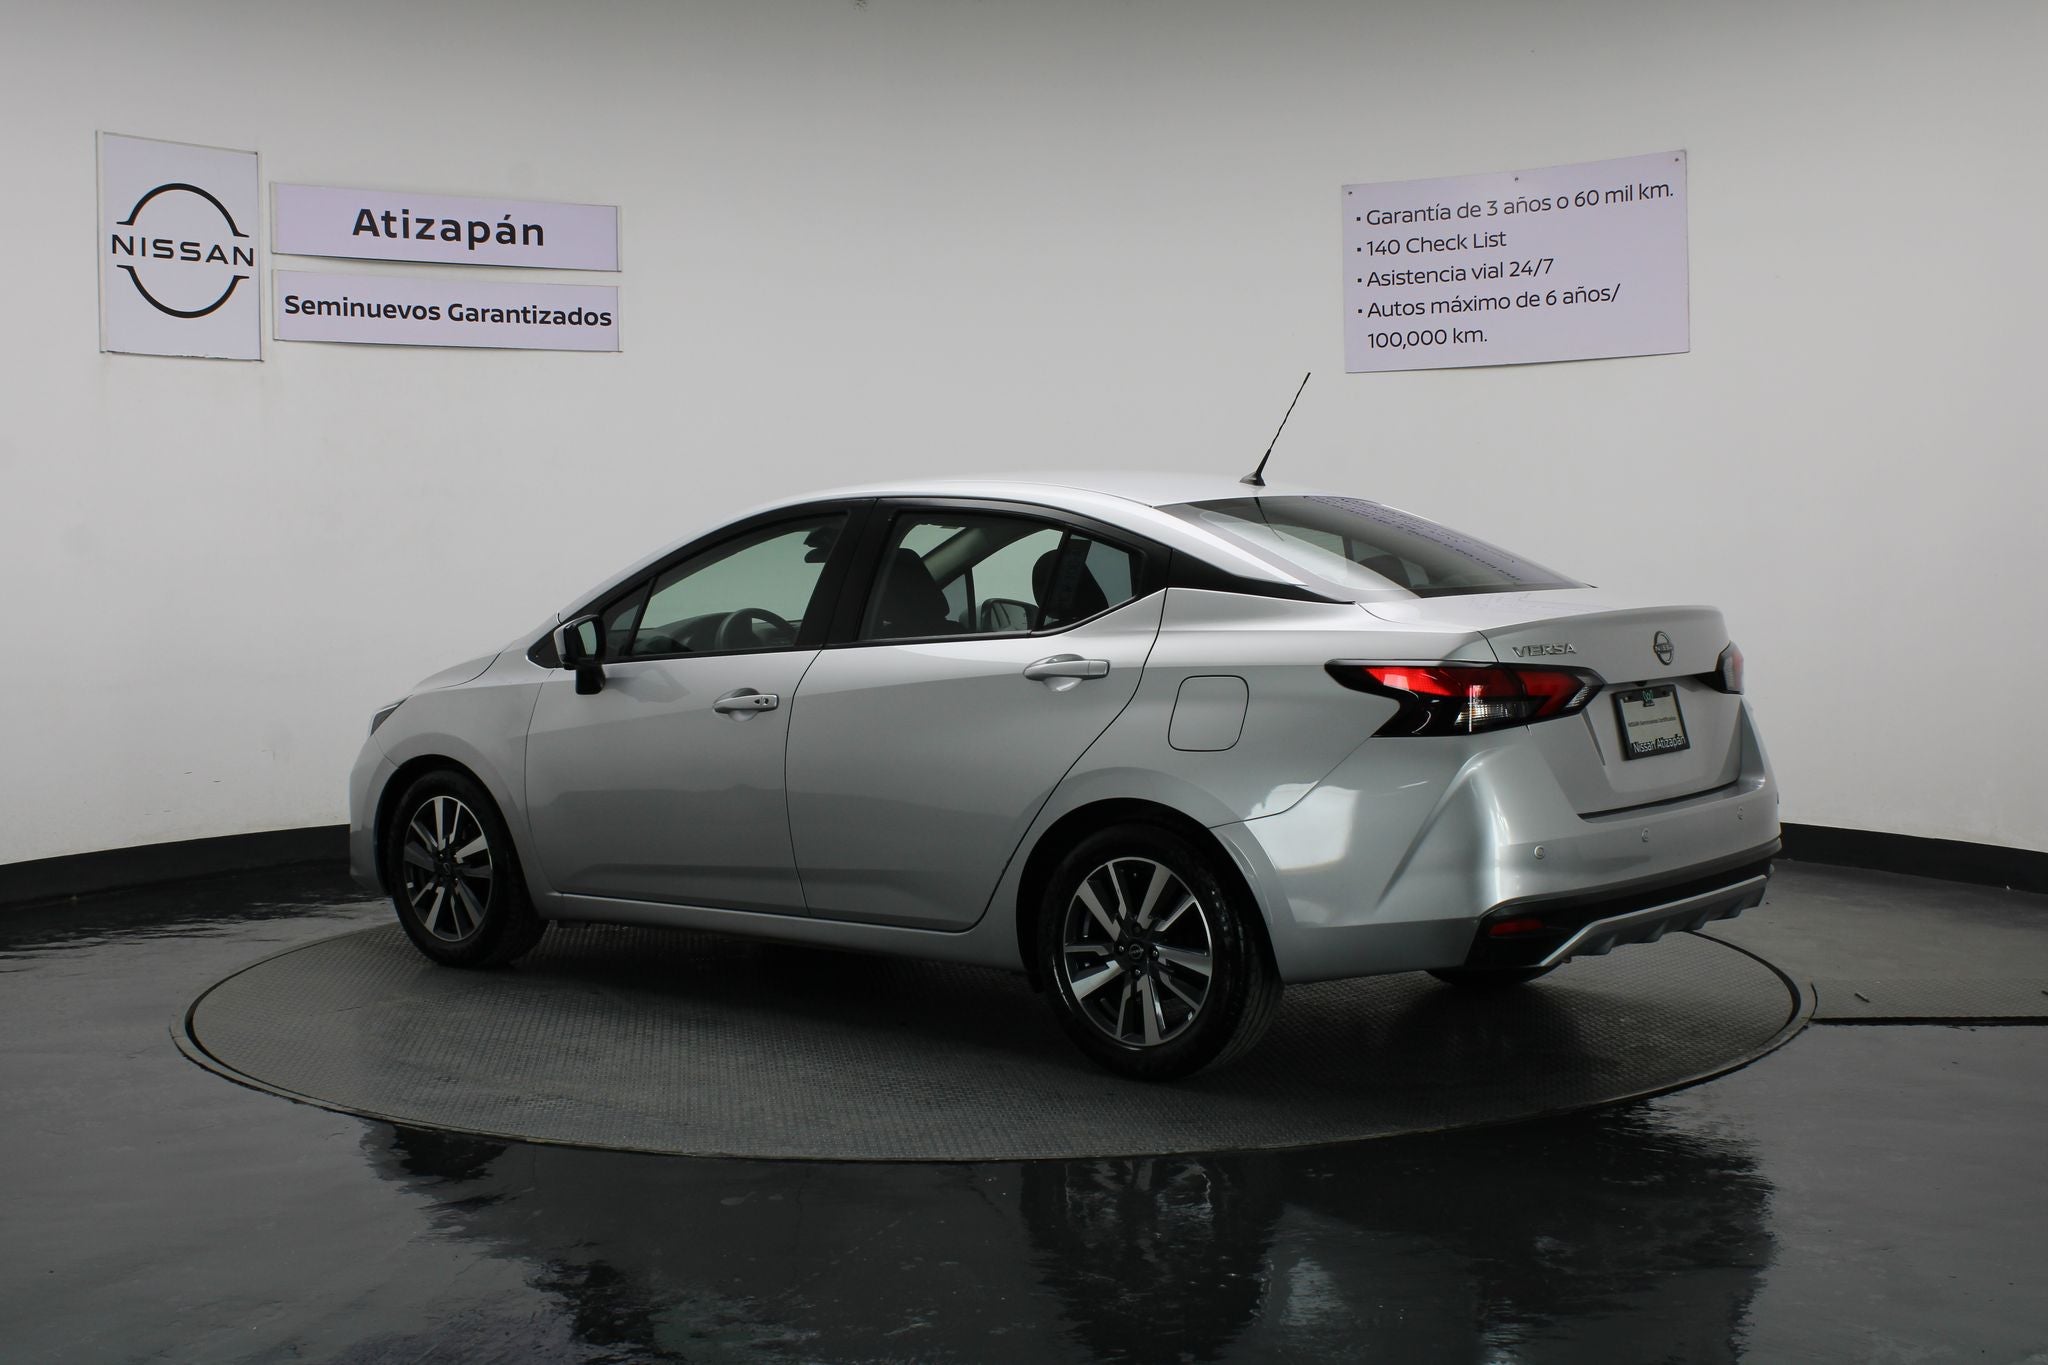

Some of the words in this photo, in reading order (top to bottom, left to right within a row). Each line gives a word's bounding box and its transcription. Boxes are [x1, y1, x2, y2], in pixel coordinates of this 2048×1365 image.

[1366, 203, 1452, 226] Garantía
[1456, 201, 1482, 219] de
[1486, 200, 1498, 217] 3
[1503, 196, 1552, 215] años
[1556, 196, 1569, 210] o
[1574, 189, 1600, 208] 60
[1605, 184, 1633, 205] mil
[1638, 183, 1674, 201] km.
[352, 208, 544, 251] Atizapán
[1366, 239, 1401, 257] 140
[1405, 233, 1468, 254] Check
[1473, 231, 1507, 249] List
[111, 233, 254, 267] NISSAN
[1366, 268, 1467, 288] Asistencia
[1471, 261, 1504, 280] vial
[1509, 257, 1555, 278] 24/7
[284, 294, 441, 321] Seminuevos
[447, 303, 612, 327] Garantizados
[1367, 301, 1426, 318] Autos
[1430, 294, 1511, 315] máximo
[1516, 290, 1541, 309] de
[1545, 289, 1558, 306] 6
[1562, 283, 1621, 305] años/
[1367, 328, 1448, 350] 100,000
[1453, 327, 1488, 344] km.
[1512, 643, 1577, 658] VERSA
[1633, 741, 1656, 753] Nissan
